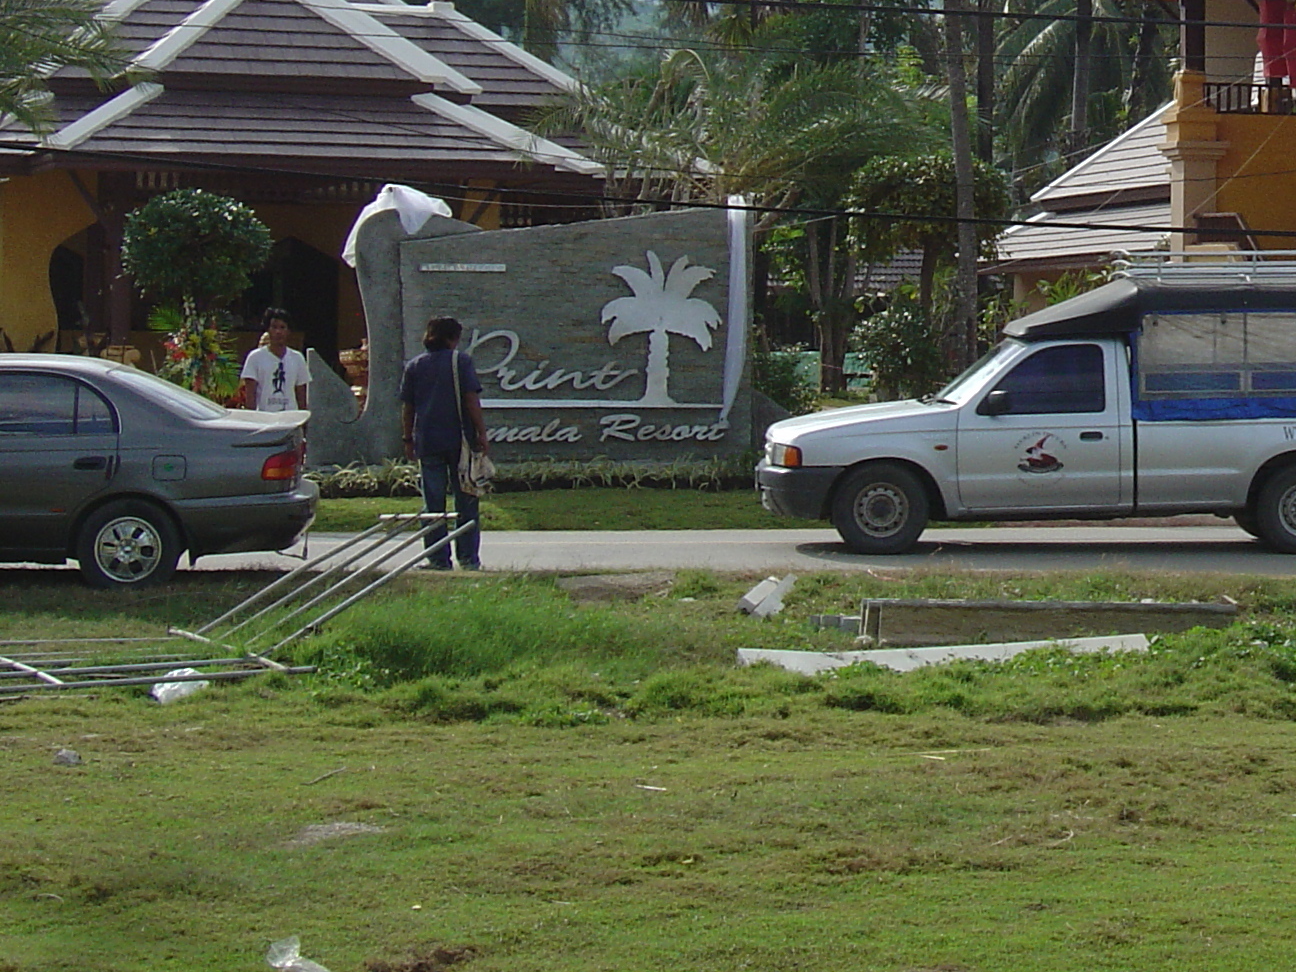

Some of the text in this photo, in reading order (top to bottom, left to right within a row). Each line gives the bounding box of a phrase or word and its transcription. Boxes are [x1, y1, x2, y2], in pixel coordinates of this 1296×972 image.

[465, 329, 638, 391] Print
[486, 413, 727, 443] mala Resort
